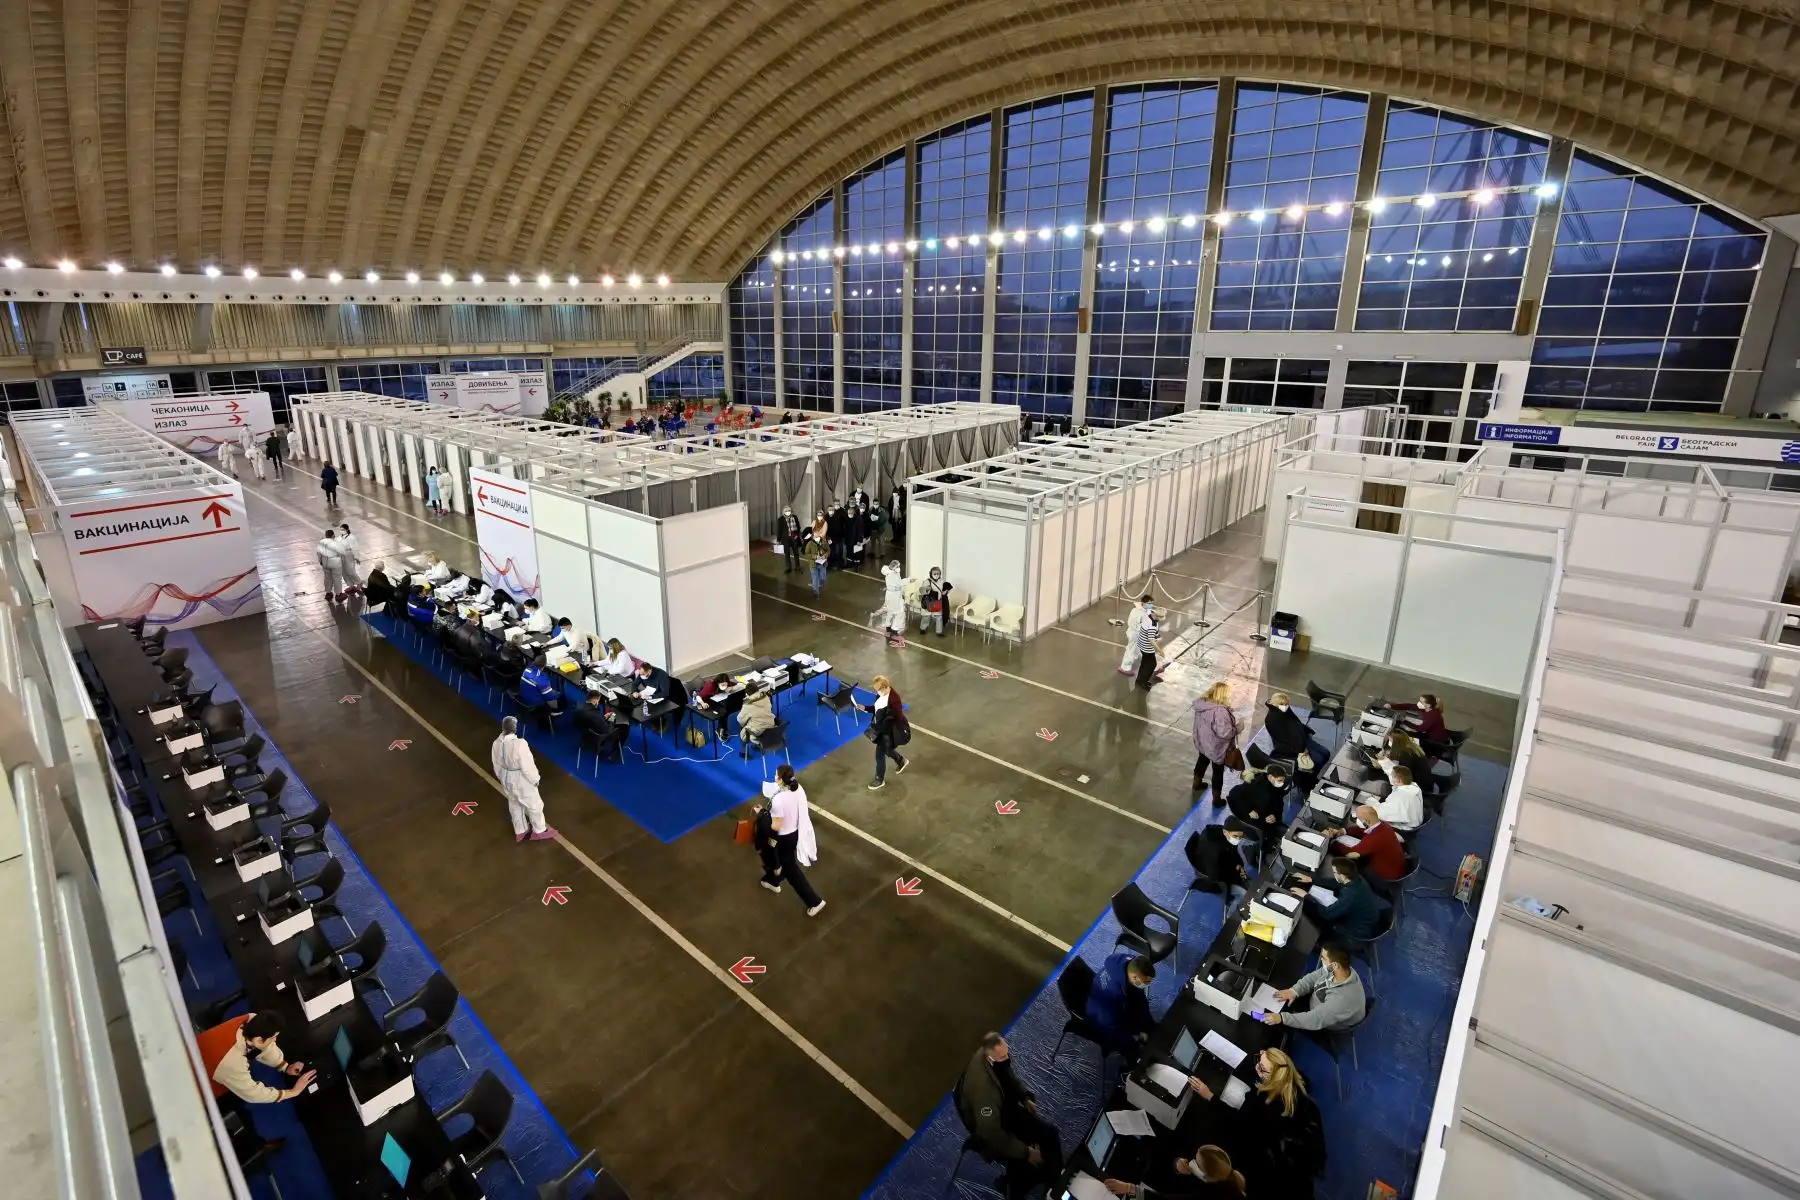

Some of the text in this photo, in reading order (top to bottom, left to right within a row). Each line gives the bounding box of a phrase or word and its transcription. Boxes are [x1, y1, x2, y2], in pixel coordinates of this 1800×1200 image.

[468, 380, 508, 388] ДОВИЂЕЊА
[151, 404, 211, 415] ЧЕКАОНИЦА
[154, 420, 188, 429] ИЗЛАЗ
[1504, 427, 1554, 435] ИНФОРМАЦИЈЕ
[1503, 433, 1548, 441] INFORMATION
[1615, 434, 1657, 442] BELGRADE
[1681, 439, 1738, 448] БЕОГРАДСКИ
[490, 495, 529, 515] ВАКЦИНАЦИЈА
[74, 514, 190, 540] ВАКЦИНАЦИЈА
